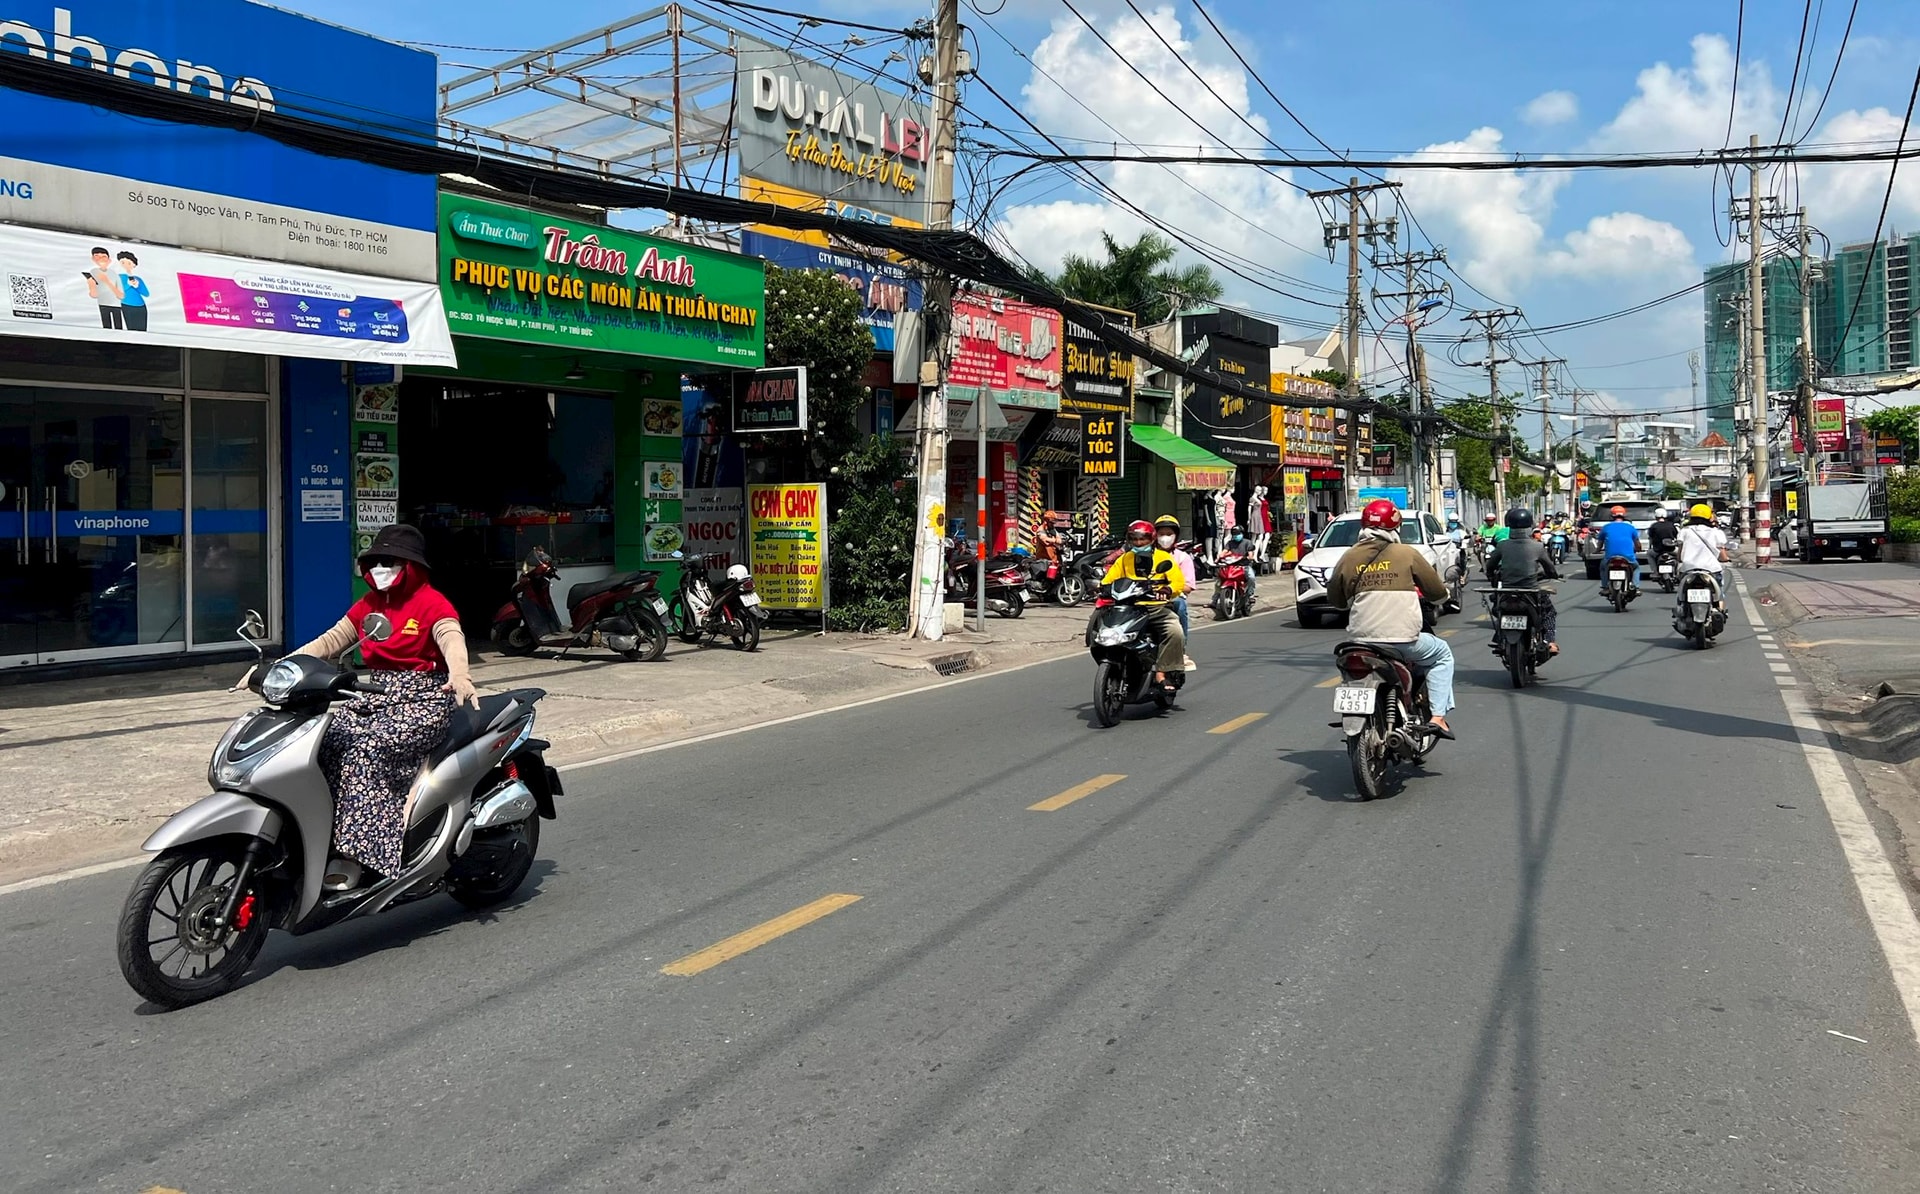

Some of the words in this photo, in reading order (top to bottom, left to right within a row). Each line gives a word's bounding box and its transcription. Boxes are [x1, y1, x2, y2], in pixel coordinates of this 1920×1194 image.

[753, 66, 876, 145] DUHAL
[128, 191, 143, 203] Số
[147, 196, 168, 207] 503
[171, 199, 185, 210] Tô
[188, 202, 216, 217] Ngọc
[218, 206, 241, 220] Vân,
[245, 211, 254, 222] P.
[257, 213, 277, 226] Tam
[351, 229, 364, 240] TP.
[366, 231, 388, 243] HCM
[480, 221, 504, 241] Thực
[505, 226, 529, 245] Chay
[288, 231, 310, 243] Điện
[315, 236, 341, 249] thoại:
[343, 240, 365, 252] 1800
[365, 243, 388, 255] 1166
[543, 226, 628, 275] Trâm
[634, 246, 696, 288] Anh
[818, 252, 832, 265] CTY
[454, 258, 510, 296] PHỤC
[516, 269, 542, 301] VỤ
[547, 274, 585, 300] CÁC
[591, 281, 632, 308] MÓN
[637, 286, 661, 313] ĂN
[665, 293, 719, 321] THUẦN
[721, 302, 757, 327] CHAY
[560, 325, 568, 333] TP
[1066, 342, 1106, 376] Barber
[1107, 351, 1135, 387] Shop
[1218, 357, 1246, 375] Fashion
[381, 413, 397, 421] CHAY
[770, 406, 793, 421] Anh
[1088, 417, 1114, 436] CẮT
[1087, 438, 1114, 454] TÓC
[311, 464, 329, 473] 503
[1084, 461, 1117, 474] NAM
[358, 502, 373, 513] CẦN
[374, 502, 395, 513] TUYỂN
[751, 486, 781, 518] CƠM
[785, 489, 817, 518] CHAY
[74, 515, 150, 531] vinaphone
[359, 514, 380, 524] NAM,
[382, 513, 396, 523] NỮ
[688, 521, 736, 545] NGỌC
[800, 564, 818, 575] CHAY
[1340, 690, 1369, 701] 34-P5
[1339, 702, 1368, 711] 4351
